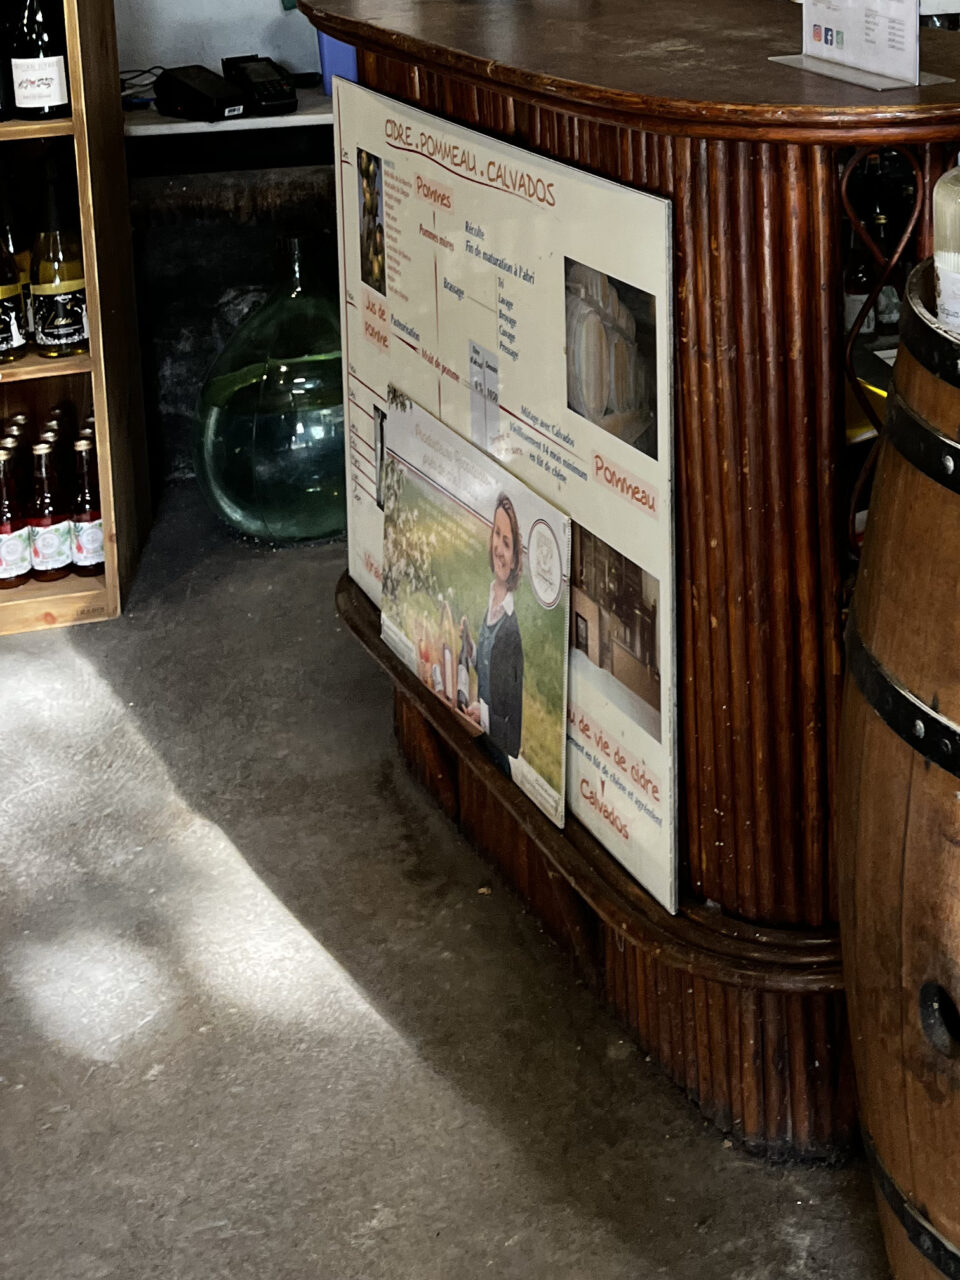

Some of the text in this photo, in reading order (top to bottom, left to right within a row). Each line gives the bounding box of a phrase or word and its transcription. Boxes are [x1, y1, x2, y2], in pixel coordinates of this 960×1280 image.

[385, 118, 556, 208] CIDRE POMMEAU CALVADOS
[416, 175, 452, 209] Pommes
[419, 223, 439, 244] Pommes
[465, 220, 485, 241] Récolte
[465, 240, 474, 255] Fin
[475, 244, 482, 258] de
[482, 250, 513, 274] maturation
[519, 265, 535, 286] l'abri
[365, 296, 377, 316] Jus
[498, 293, 514, 311] Lavage
[499, 340, 519, 363] Pressage
[540, 418, 552, 432] avec
[552, 424, 575, 449] Calvados
[542, 443, 550, 456] 14
[562, 457, 588, 482] minimum
[593, 454, 656, 512] Pommeau
[578, 715, 592, 740] de
[594, 730, 611, 758] vie
[613, 746, 628, 773] de
[630, 762, 660, 802] cidre
[580, 777, 630, 841] Calvados
